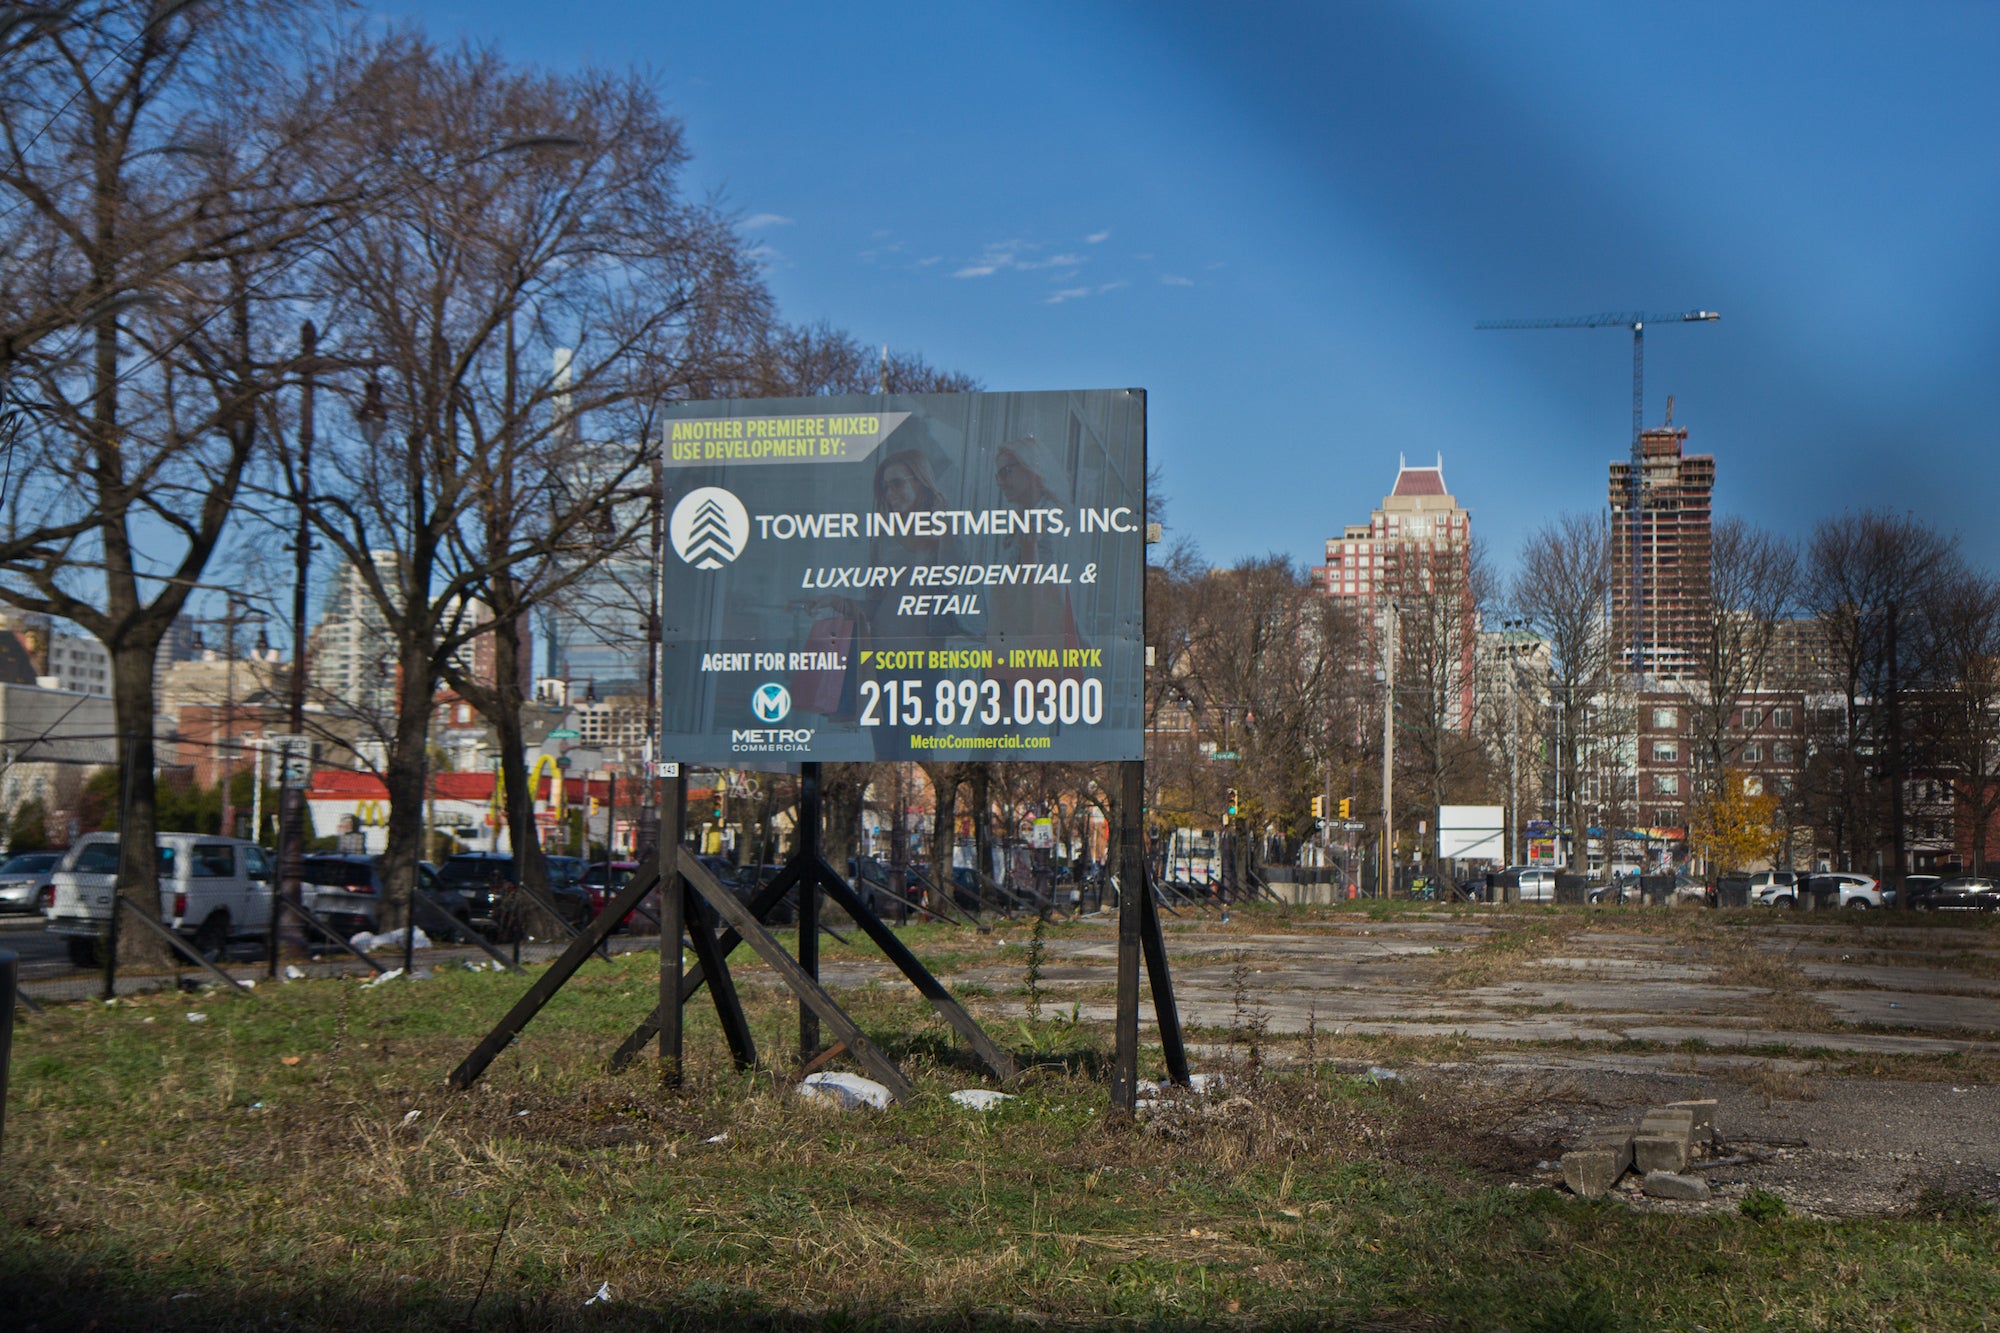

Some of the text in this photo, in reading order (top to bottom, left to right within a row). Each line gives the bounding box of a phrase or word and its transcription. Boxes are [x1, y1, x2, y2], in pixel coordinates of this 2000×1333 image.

[671, 417, 880, 440] ANOTHER PREMIERE MIXED
[672, 438, 846, 460] USE DEVELOPMENT BY:
[755, 506, 1138, 540] TOWER INVESTMENTS, INC.
[802, 562, 1097, 589] LUXURY RESIDENTIAL &
[897, 594, 981, 616] RETAIL
[701, 652, 847, 672] AGENT FOR RETAIL:
[876, 649, 1102, 670] SCOTT BENSON IRYNA IRYK
[860, 678, 1103, 726] 215.893.0300
[732, 744, 811, 752] COMMERCIAL
[911, 734, 1051, 749] MetroCommercial.com
[662, 765, 676, 775] 143
[1038, 831, 1049, 841] 15
